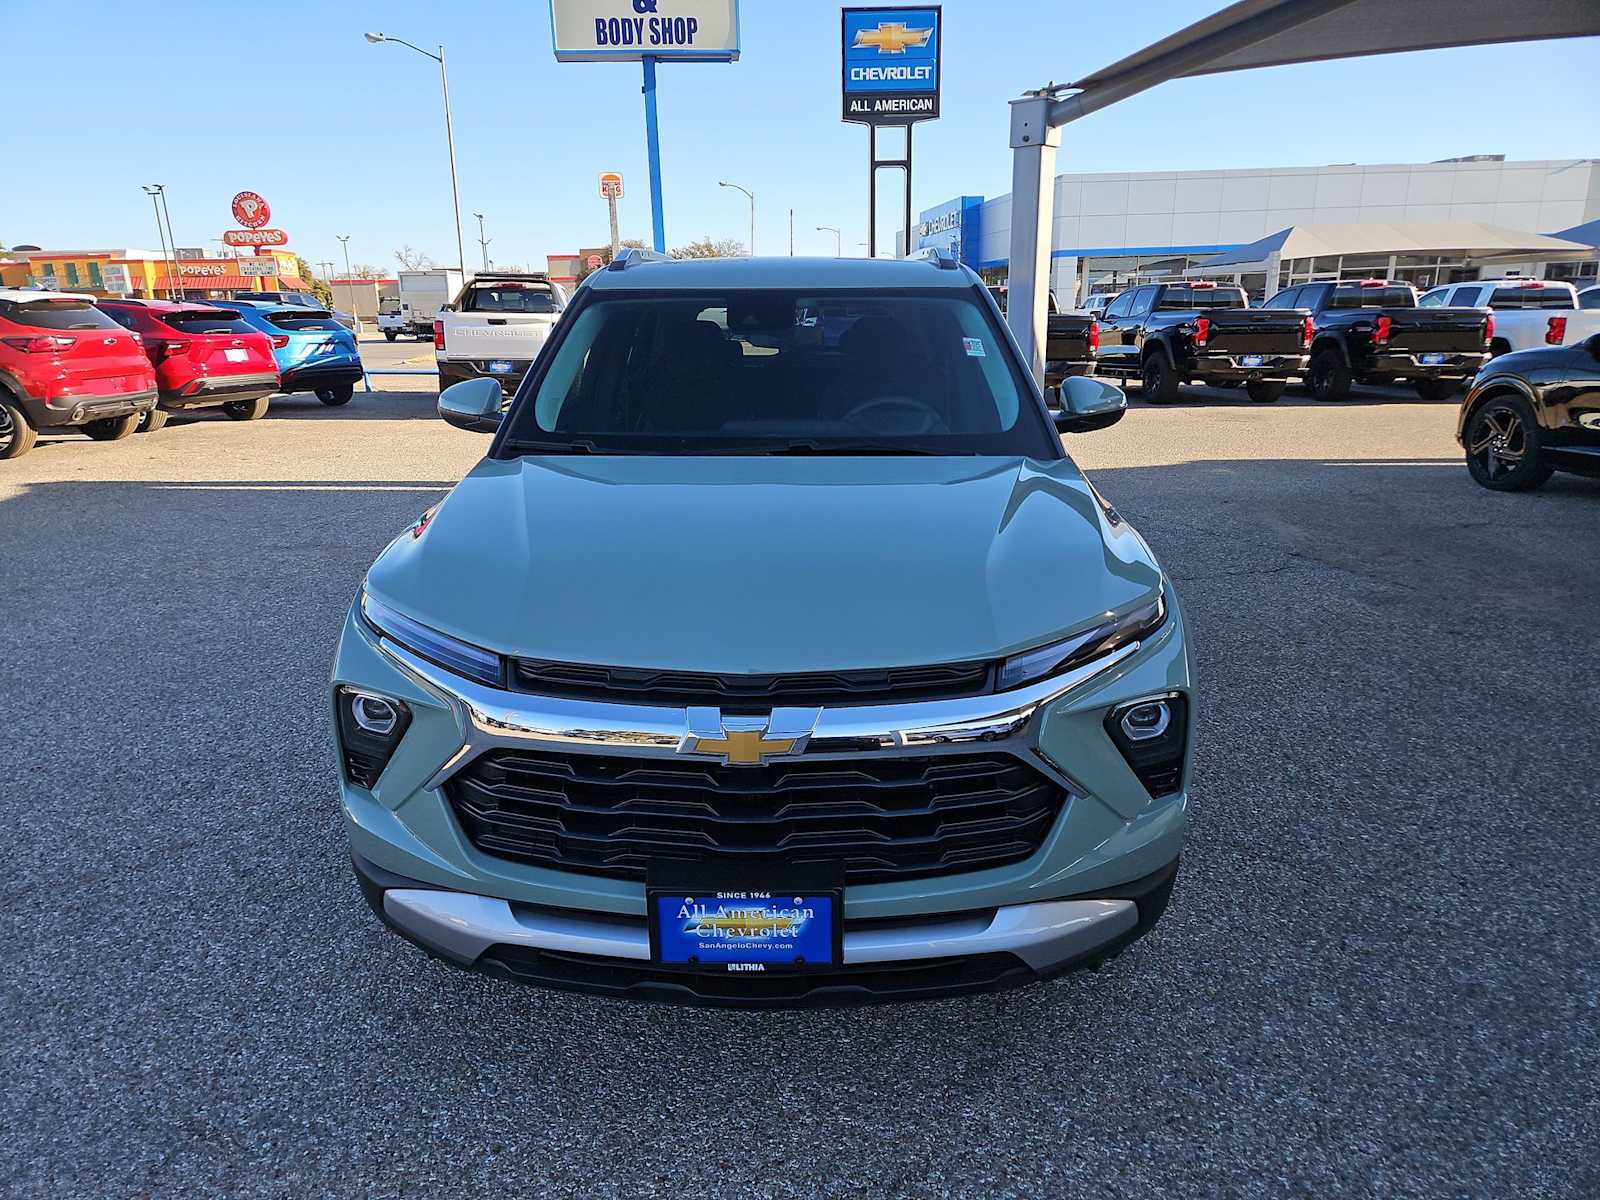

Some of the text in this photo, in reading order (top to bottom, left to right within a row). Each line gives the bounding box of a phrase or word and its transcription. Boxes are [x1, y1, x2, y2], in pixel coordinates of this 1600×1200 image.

[595, 17, 698, 46] BODY SHOP
[850, 66, 932, 81] CHEVROLET
[850, 98, 933, 112] ALL AMERICAN
[716, 892, 747, 900] SINCE
[676, 904, 815, 920] All American
[696, 922, 799, 938] Chevrolet
[698, 942, 793, 951] SanAngeloChevy.com
